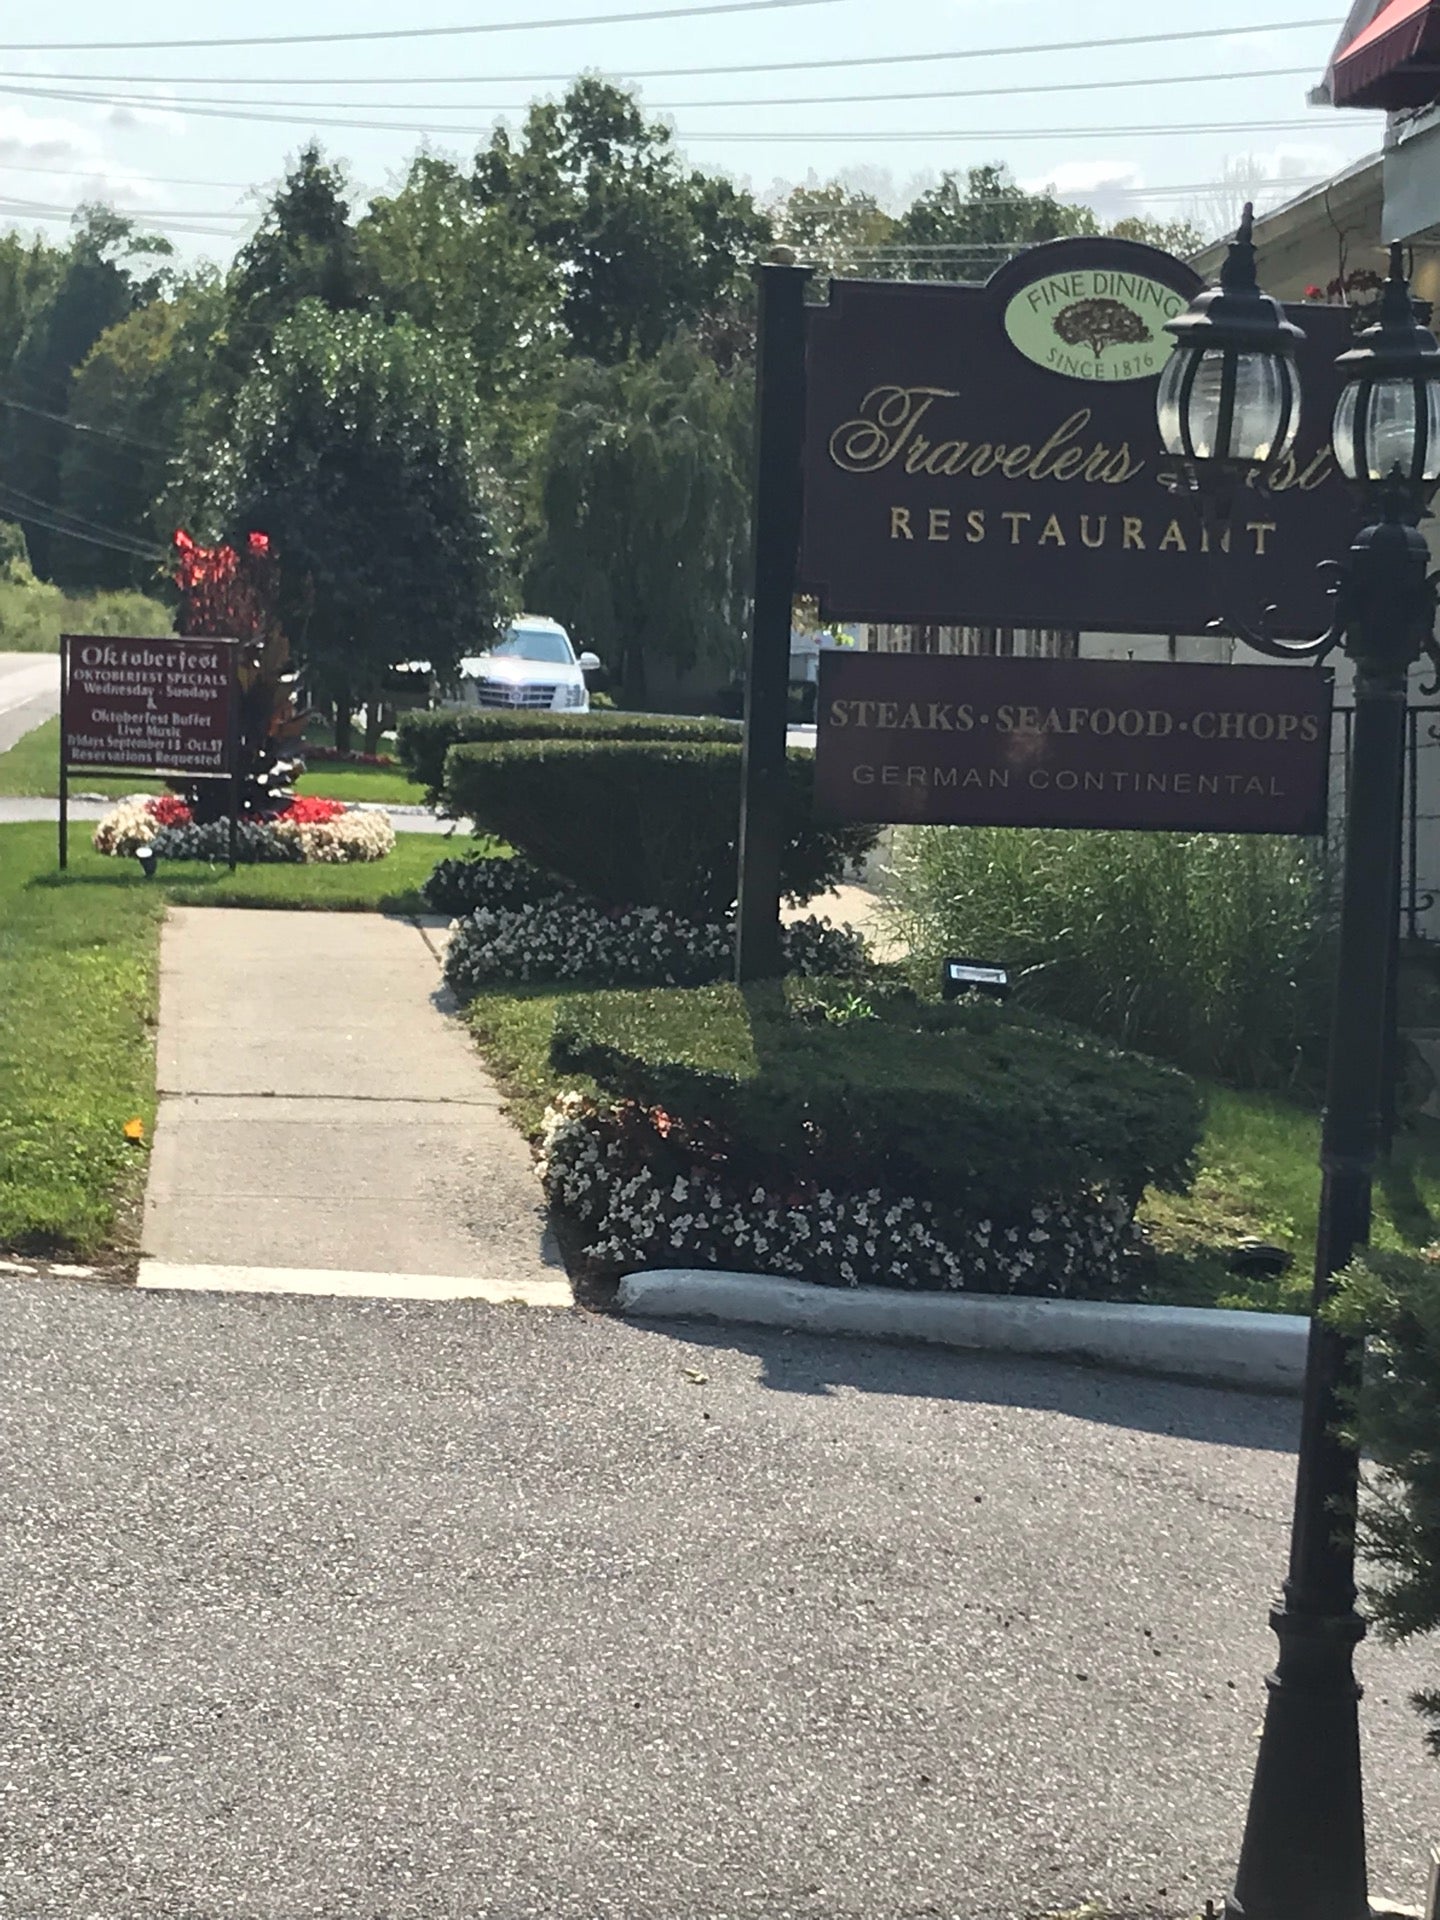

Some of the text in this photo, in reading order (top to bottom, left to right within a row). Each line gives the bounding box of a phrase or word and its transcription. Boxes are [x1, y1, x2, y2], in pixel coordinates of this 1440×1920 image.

[1027, 272, 1182, 318] FINE DINING
[1046, 348, 1154, 379] SINCE 1876
[829, 385, 1146, 483] Travelers
[81, 645, 219, 671] Oktoberfest
[73, 669, 228, 687] OKTOBERFEST SPECIALS
[83, 682, 155, 697] Wednesday
[166, 685, 218, 701] Sundays
[91, 709, 212, 727] Oktoberfest Buffet
[829, 700, 1318, 742] STEAKS SEAFOOD CHOPS
[117, 724, 182, 738] Live Music
[107, 735, 165, 750] September
[71, 748, 222, 766] Reservations Requested
[852, 764, 1286, 796] GERMAN CONTINENTAL
